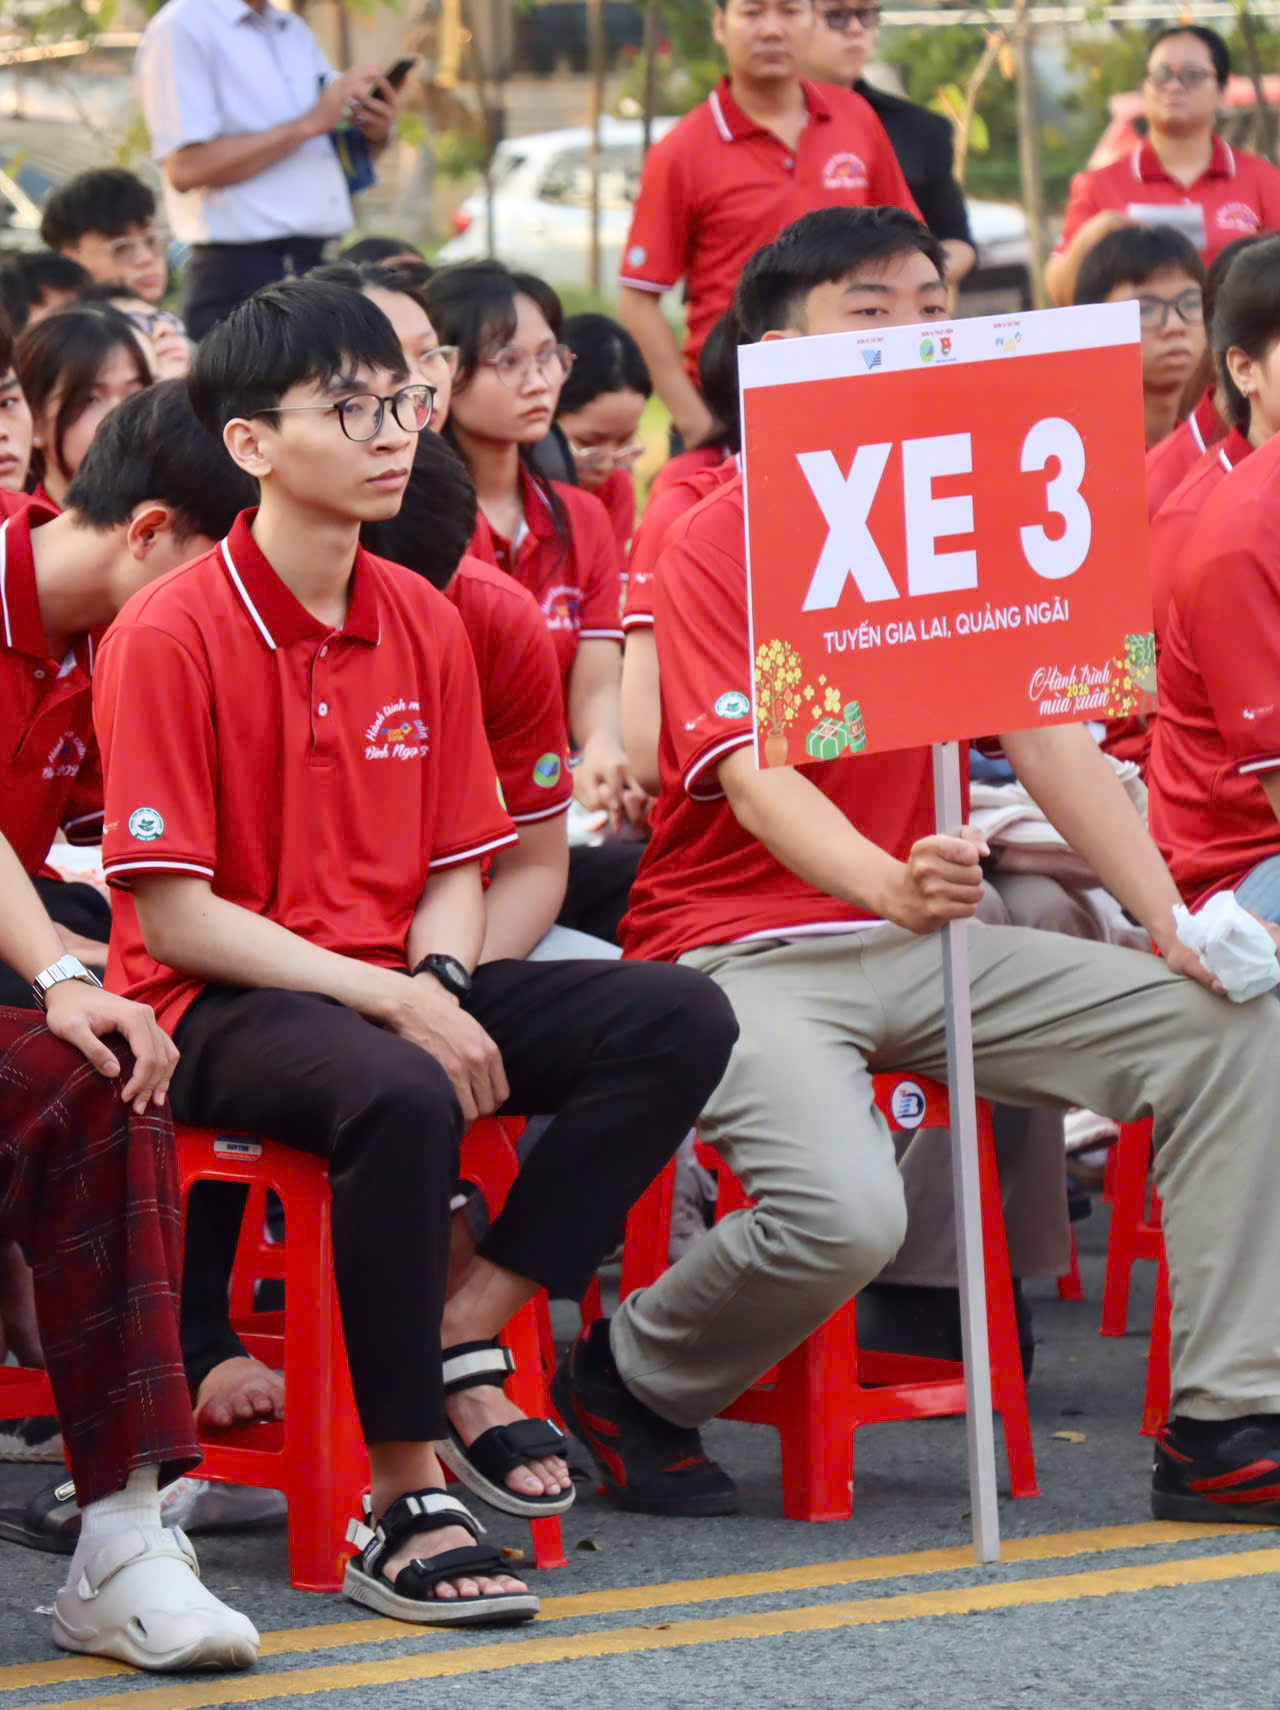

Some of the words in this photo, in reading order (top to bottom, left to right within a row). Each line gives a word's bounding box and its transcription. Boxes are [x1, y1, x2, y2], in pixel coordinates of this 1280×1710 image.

[796, 432, 979, 611] XE
[1020, 416, 1092, 579] 3
[823, 619, 881, 653] TUYẾN
[885, 621, 917, 645] GIA
[921, 616, 952, 640] LAI,
[956, 603, 1021, 635] QUẢNG
[1025, 596, 1070, 625] NGÃI
[1029, 665, 1078, 701] Hành
[1080, 660, 1112, 686] trình
[1067, 682, 1089, 698] 2026
[1040, 692, 1072, 716] mùa
[1073, 687, 1111, 715] xuân
